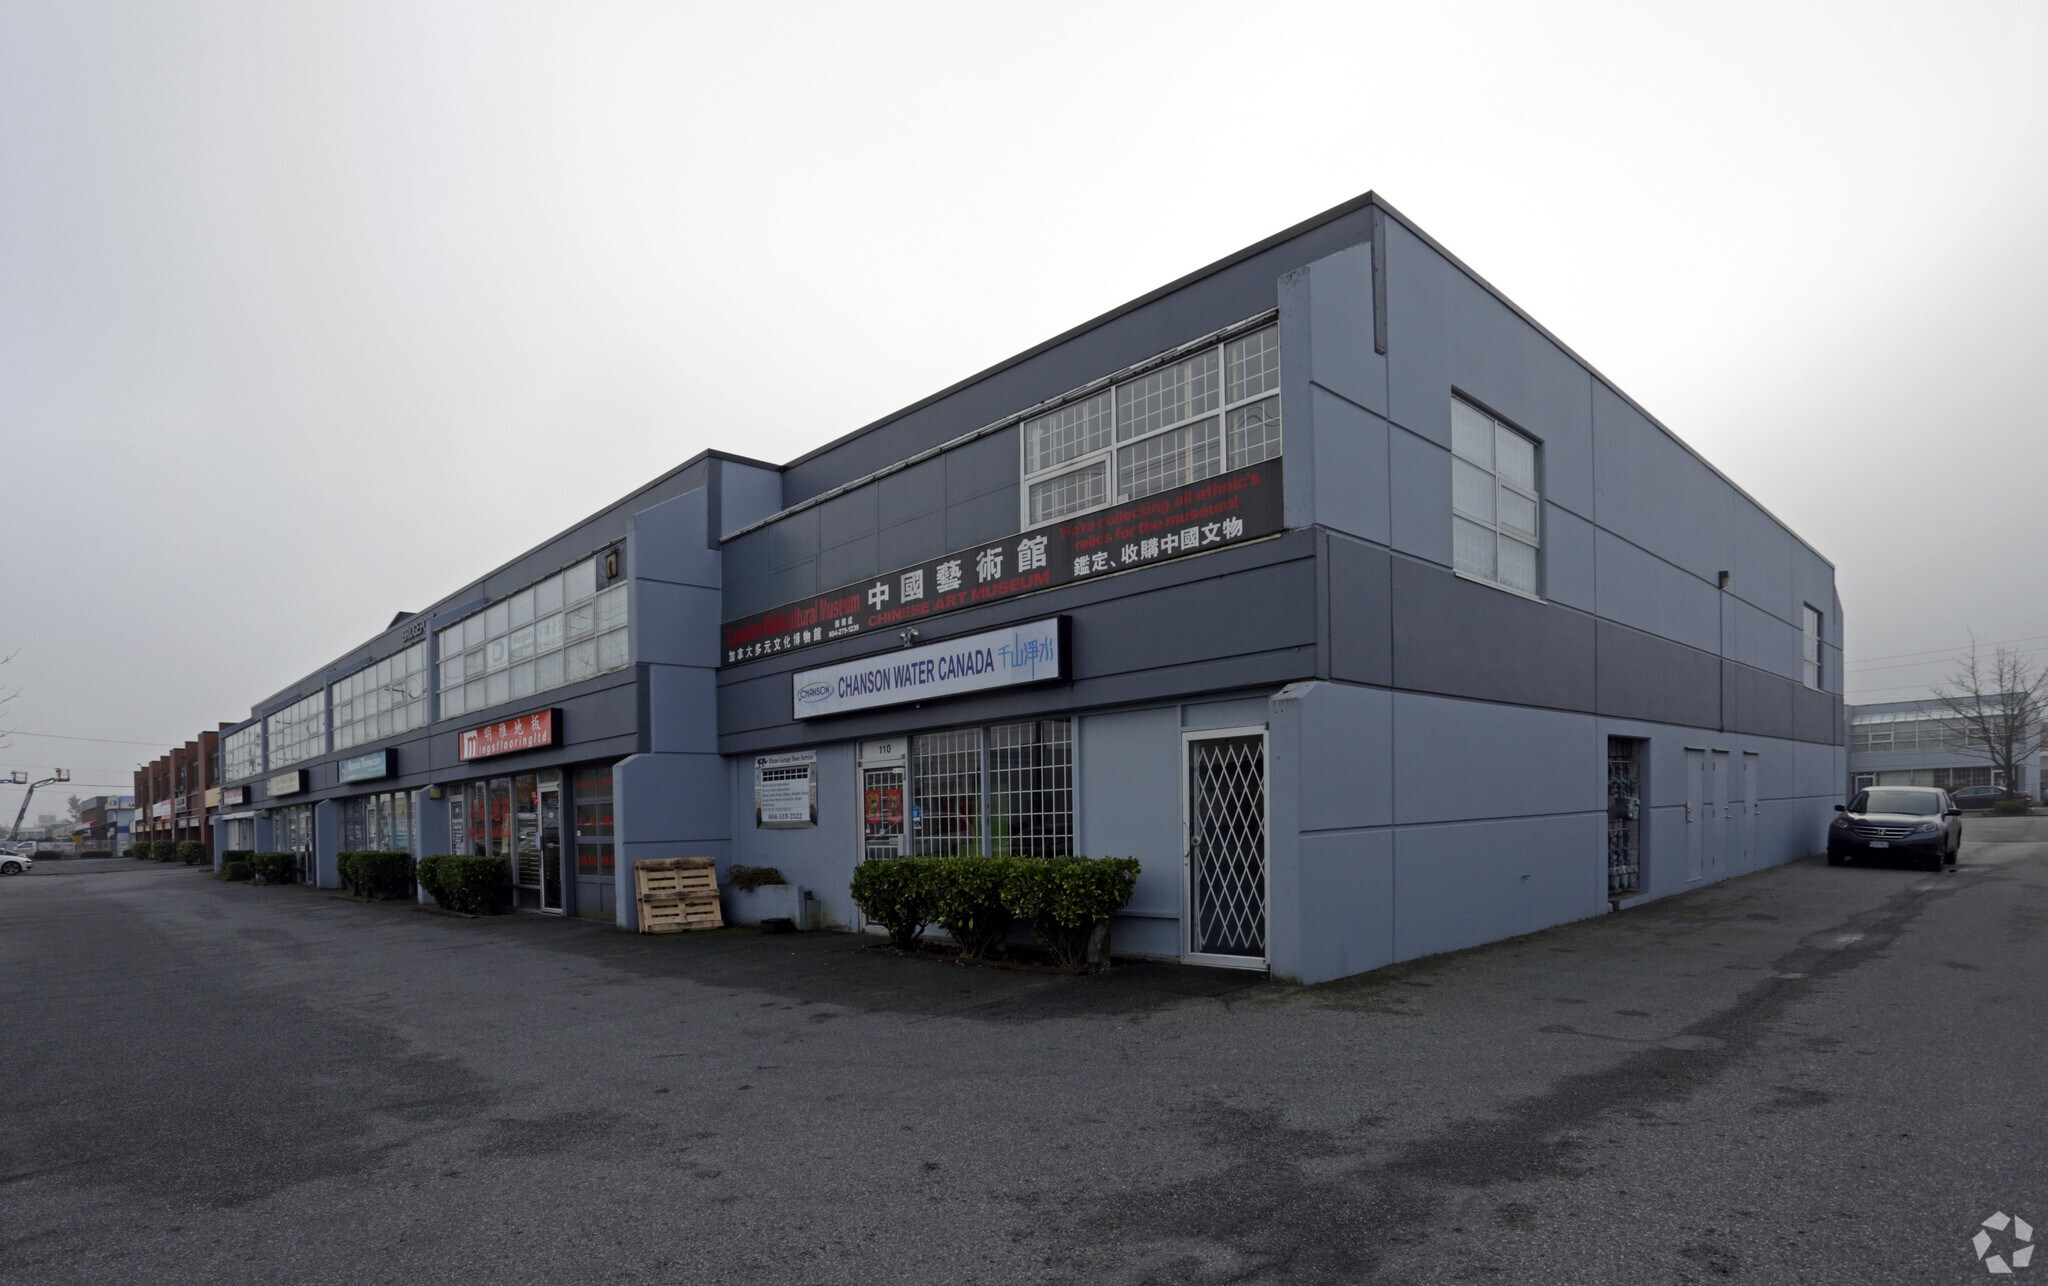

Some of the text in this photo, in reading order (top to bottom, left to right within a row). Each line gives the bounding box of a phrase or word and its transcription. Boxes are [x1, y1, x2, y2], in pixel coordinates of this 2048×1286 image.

[1059, 472, 1260, 540] We're collecting all ethnic's
[1074, 496, 1239, 550] relics for the museum!
[868, 535, 1048, 610] 中國藝術館
[820, 594, 860, 621] Museum
[867, 571, 1051, 627] CHINESE ART MUSEUM
[728, 627, 822, 662] 加拿大多元文化博物館
[800, 685, 831, 699] CHANSON
[838, 648, 994, 699] CHANSON WATER CANADA
[879, 744, 891, 754] 110
